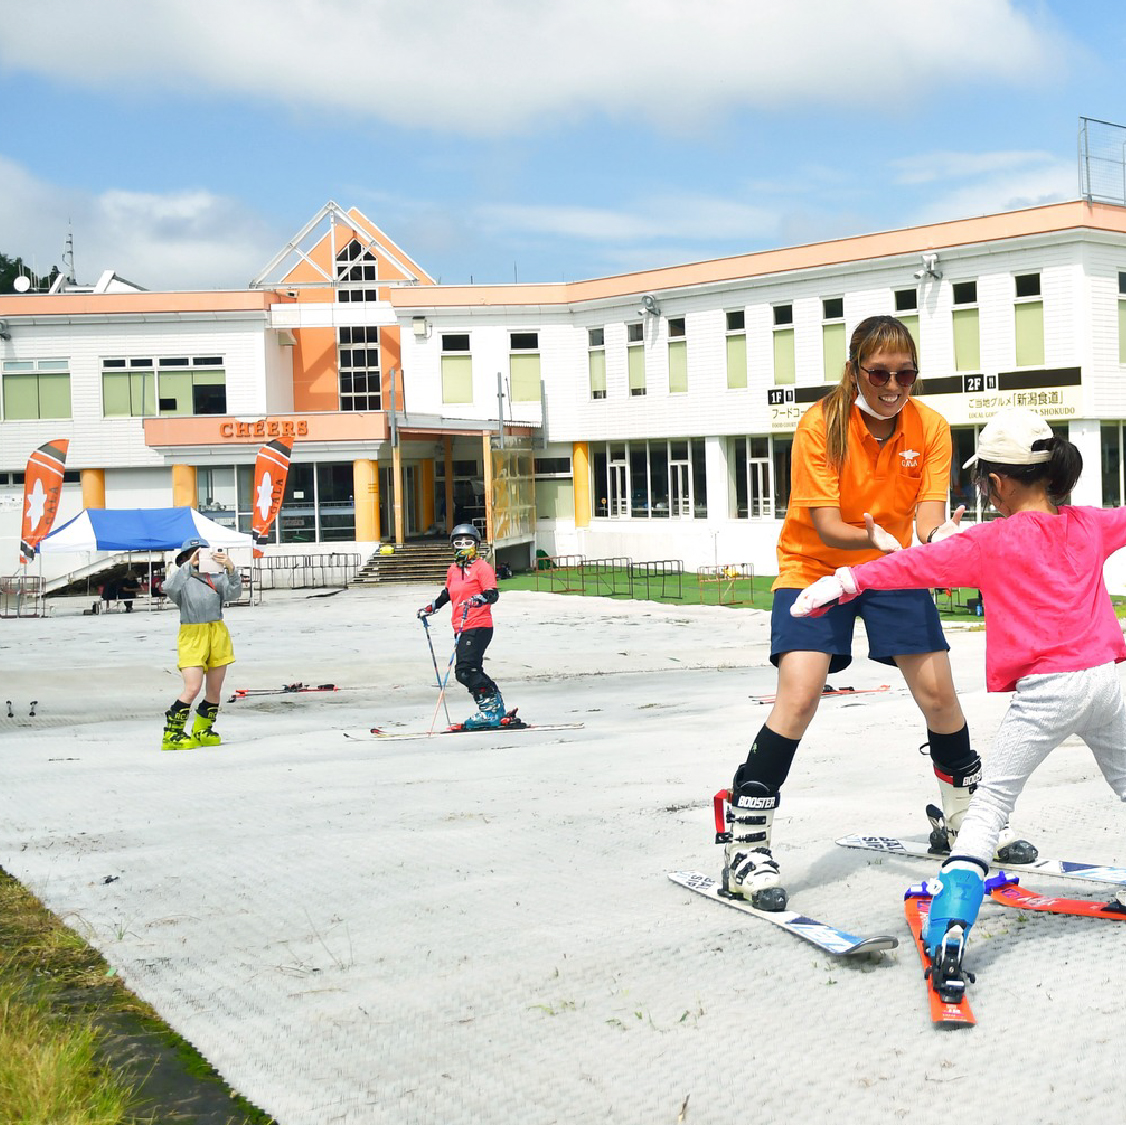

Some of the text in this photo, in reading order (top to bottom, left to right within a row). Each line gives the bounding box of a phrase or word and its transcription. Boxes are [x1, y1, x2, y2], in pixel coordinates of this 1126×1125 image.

[967, 377, 981, 391] 2F
[771, 391, 782, 403] 1F
[772, 407, 808, 419] フードコー
[1039, 407, 1075, 417] SHOKUDO
[219, 420, 308, 438] CHEERS
[737, 795, 776, 809] BOOSTER
